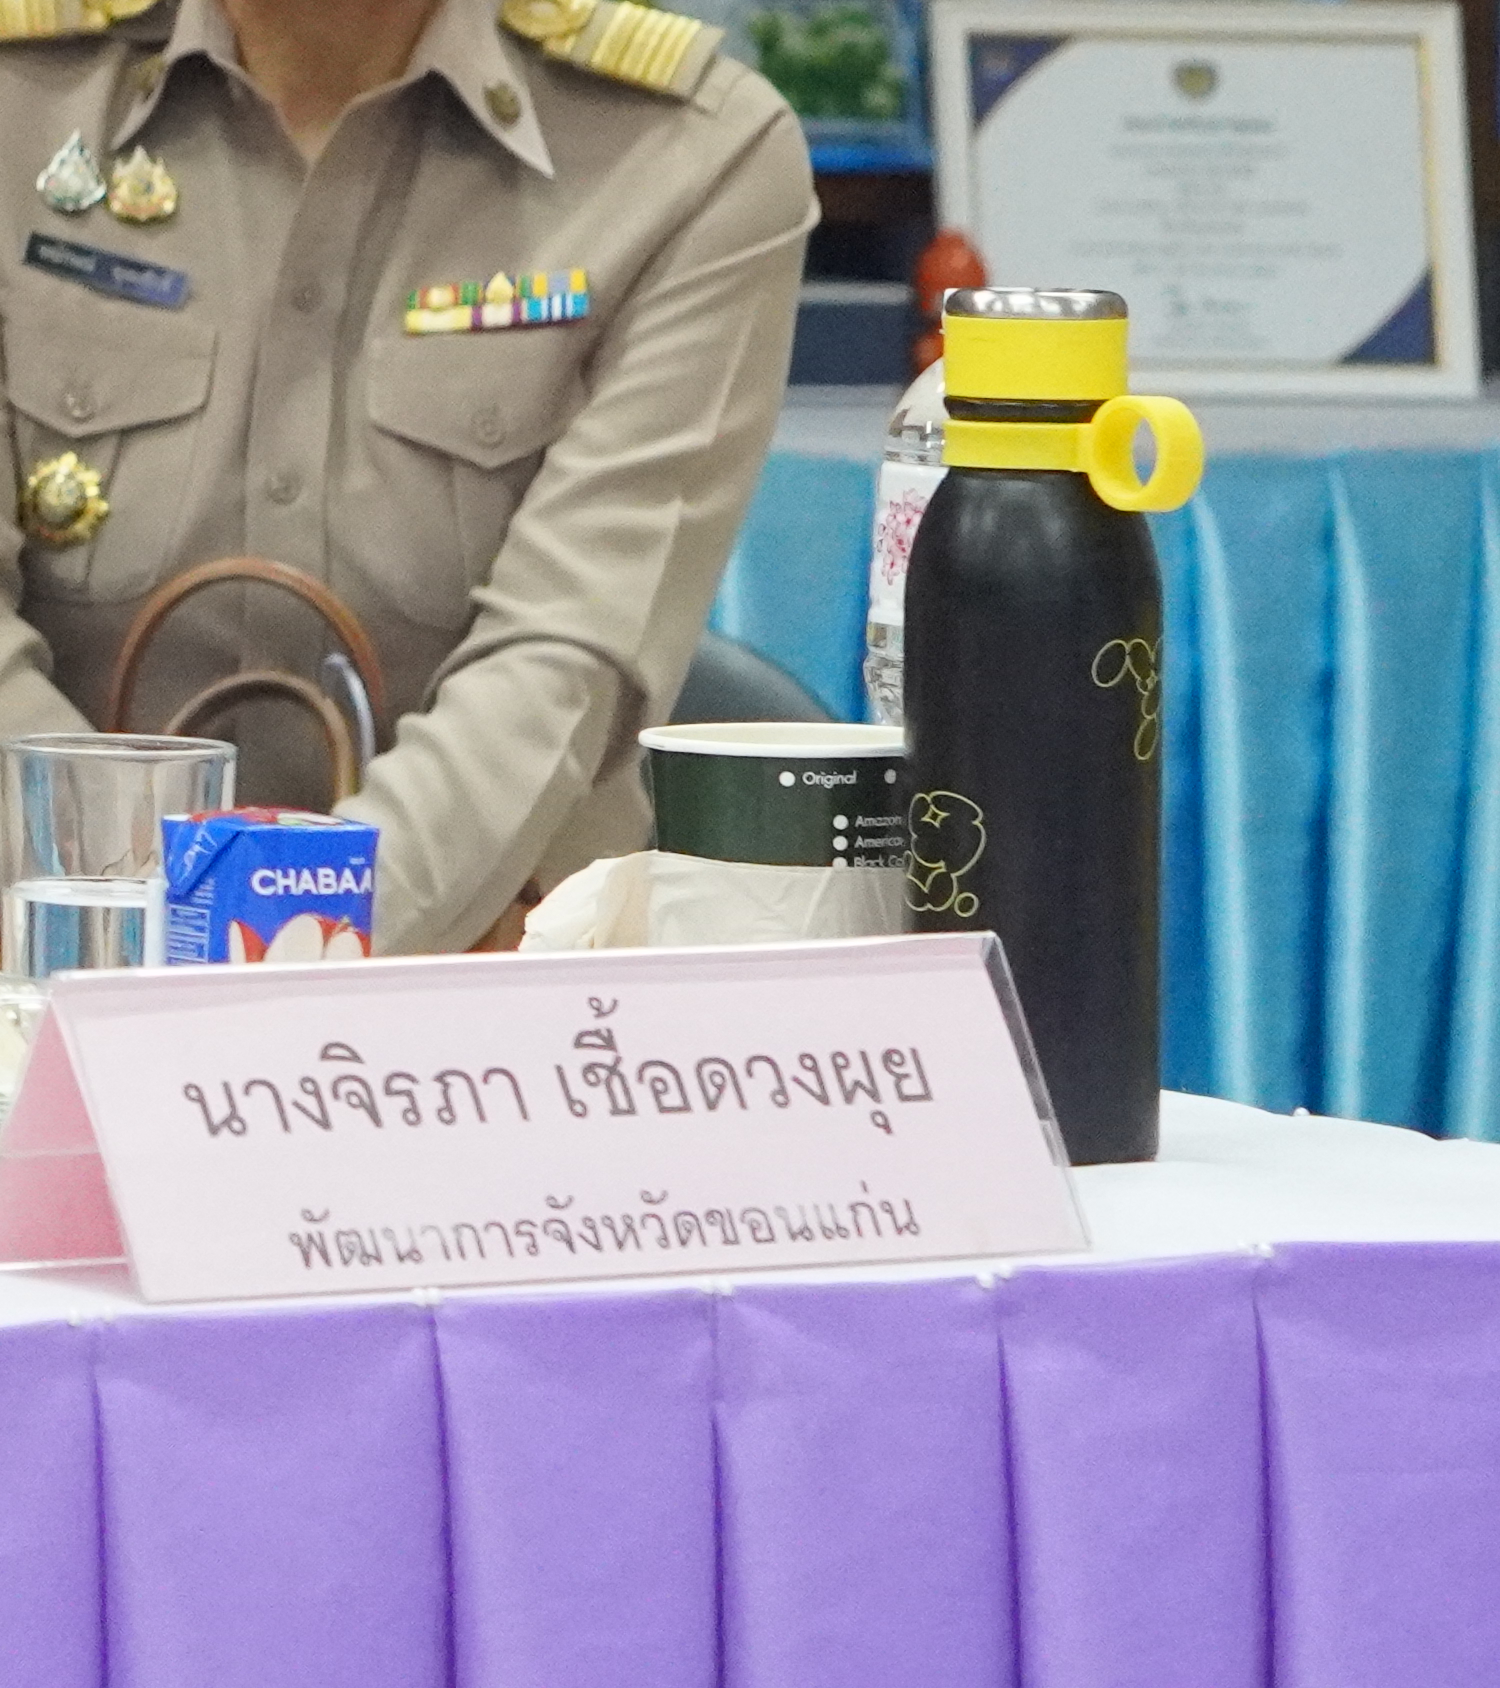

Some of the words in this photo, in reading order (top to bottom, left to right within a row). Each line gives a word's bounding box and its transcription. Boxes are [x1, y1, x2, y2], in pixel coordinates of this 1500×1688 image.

[801, 769, 858, 790] Original
[181, 1040, 531, 1138] นางจิรภา
[553, 994, 935, 1135] เชื้อดวงผุย
[287, 1180, 924, 1271] พัฒนาการจังหวัดขอนแก่น
